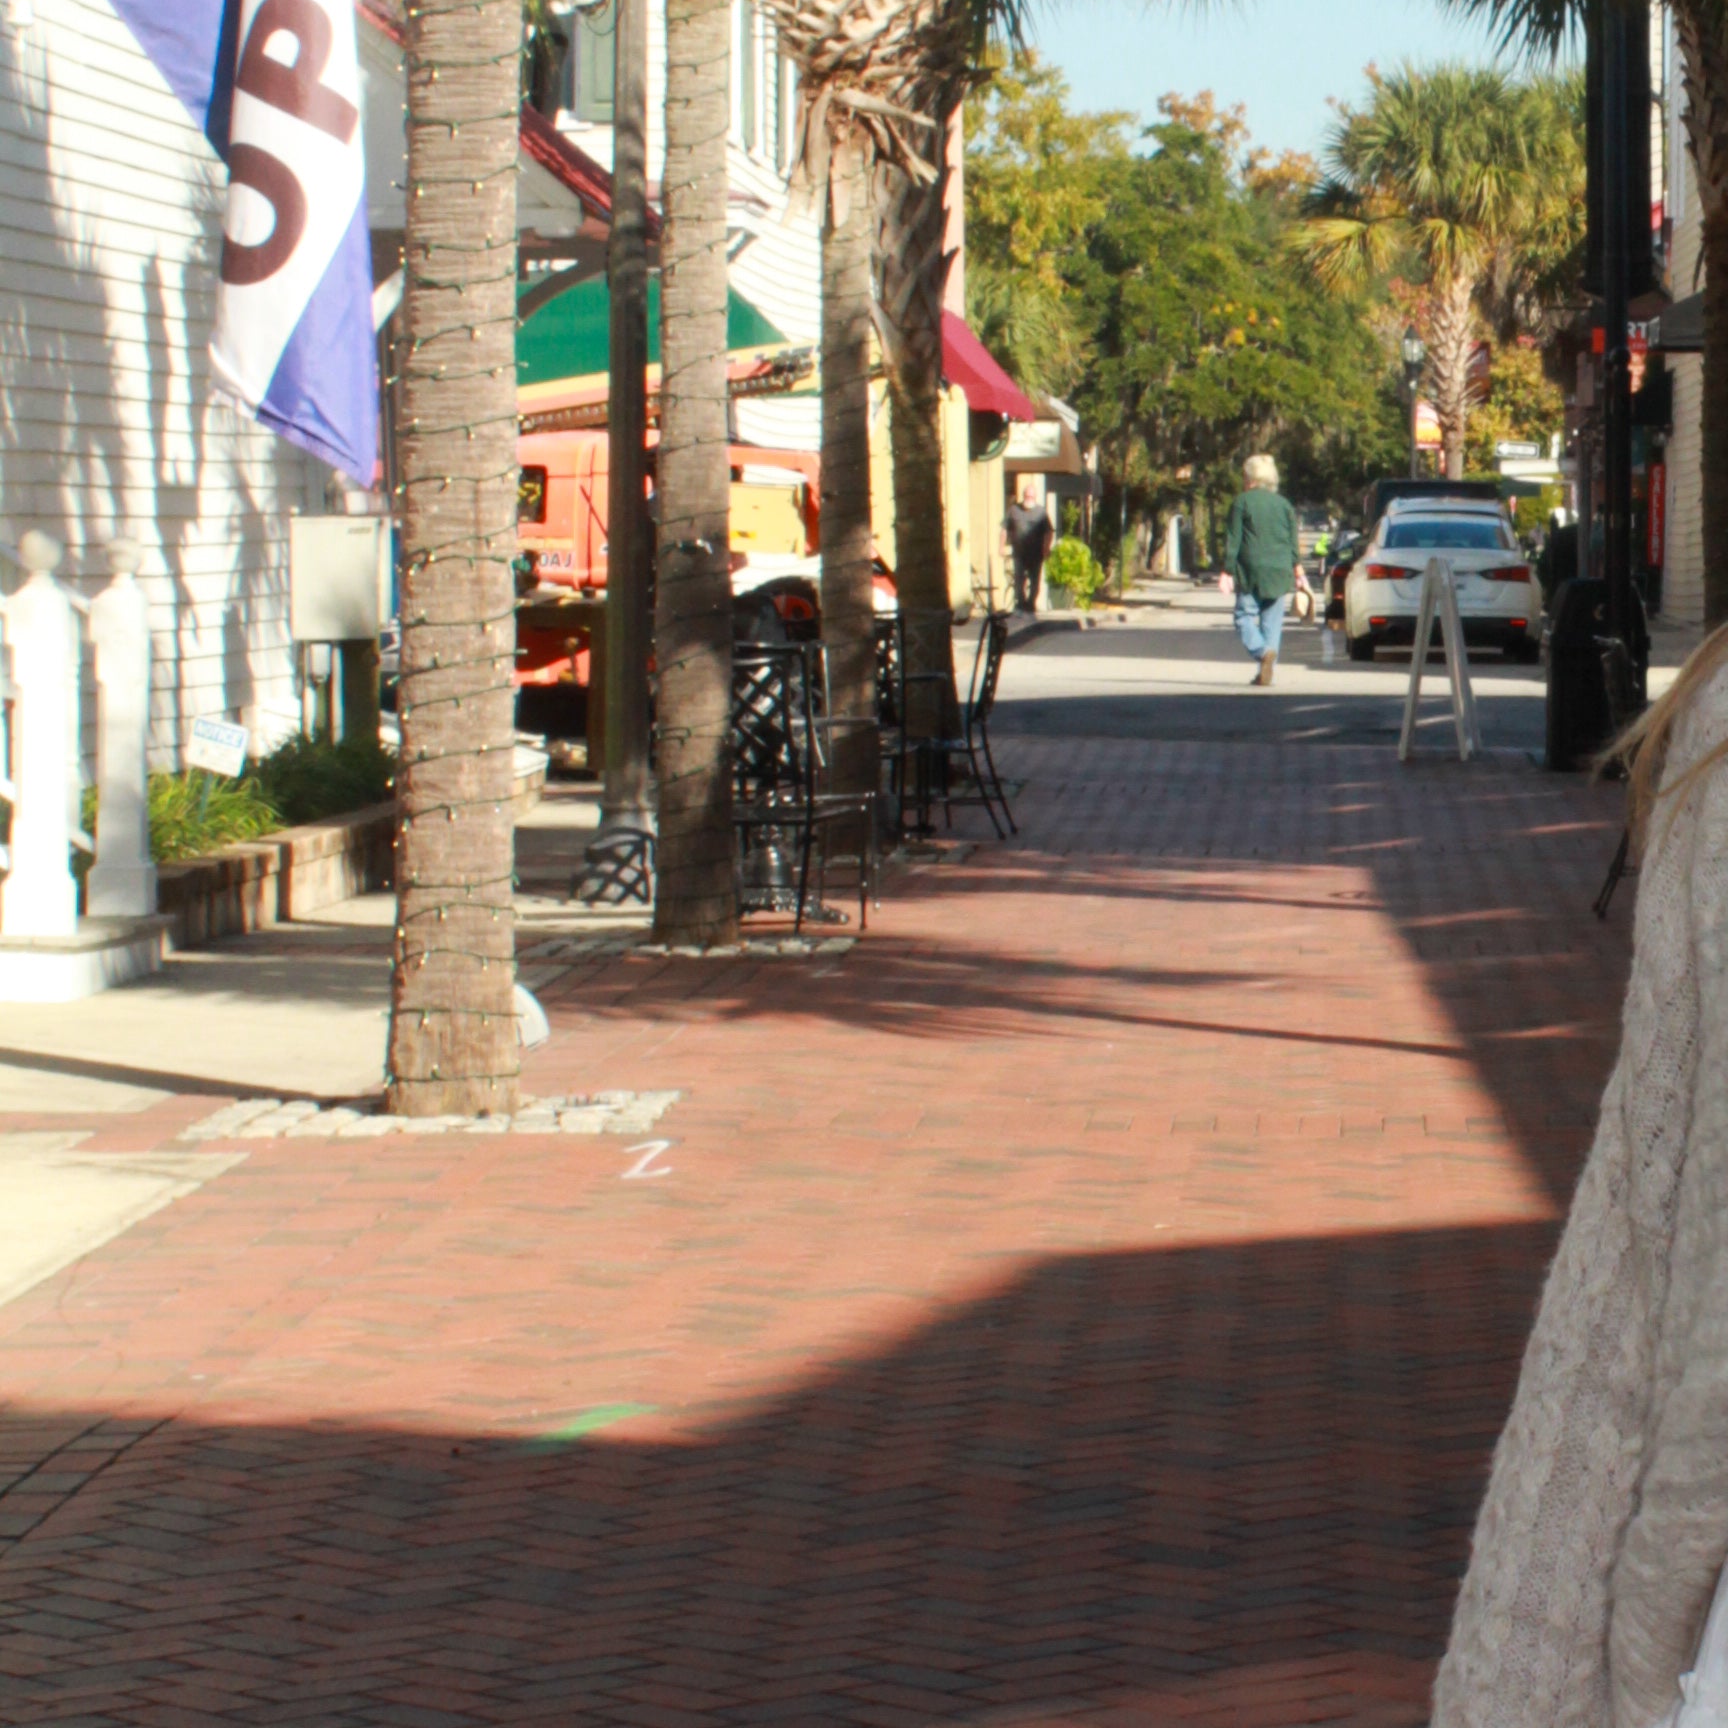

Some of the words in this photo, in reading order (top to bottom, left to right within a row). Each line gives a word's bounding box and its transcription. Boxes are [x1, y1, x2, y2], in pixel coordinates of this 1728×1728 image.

[1627, 321, 1648, 339] RT
[1651, 465, 1662, 564] GALLERY
[195, 720, 243, 748] NOTICE
